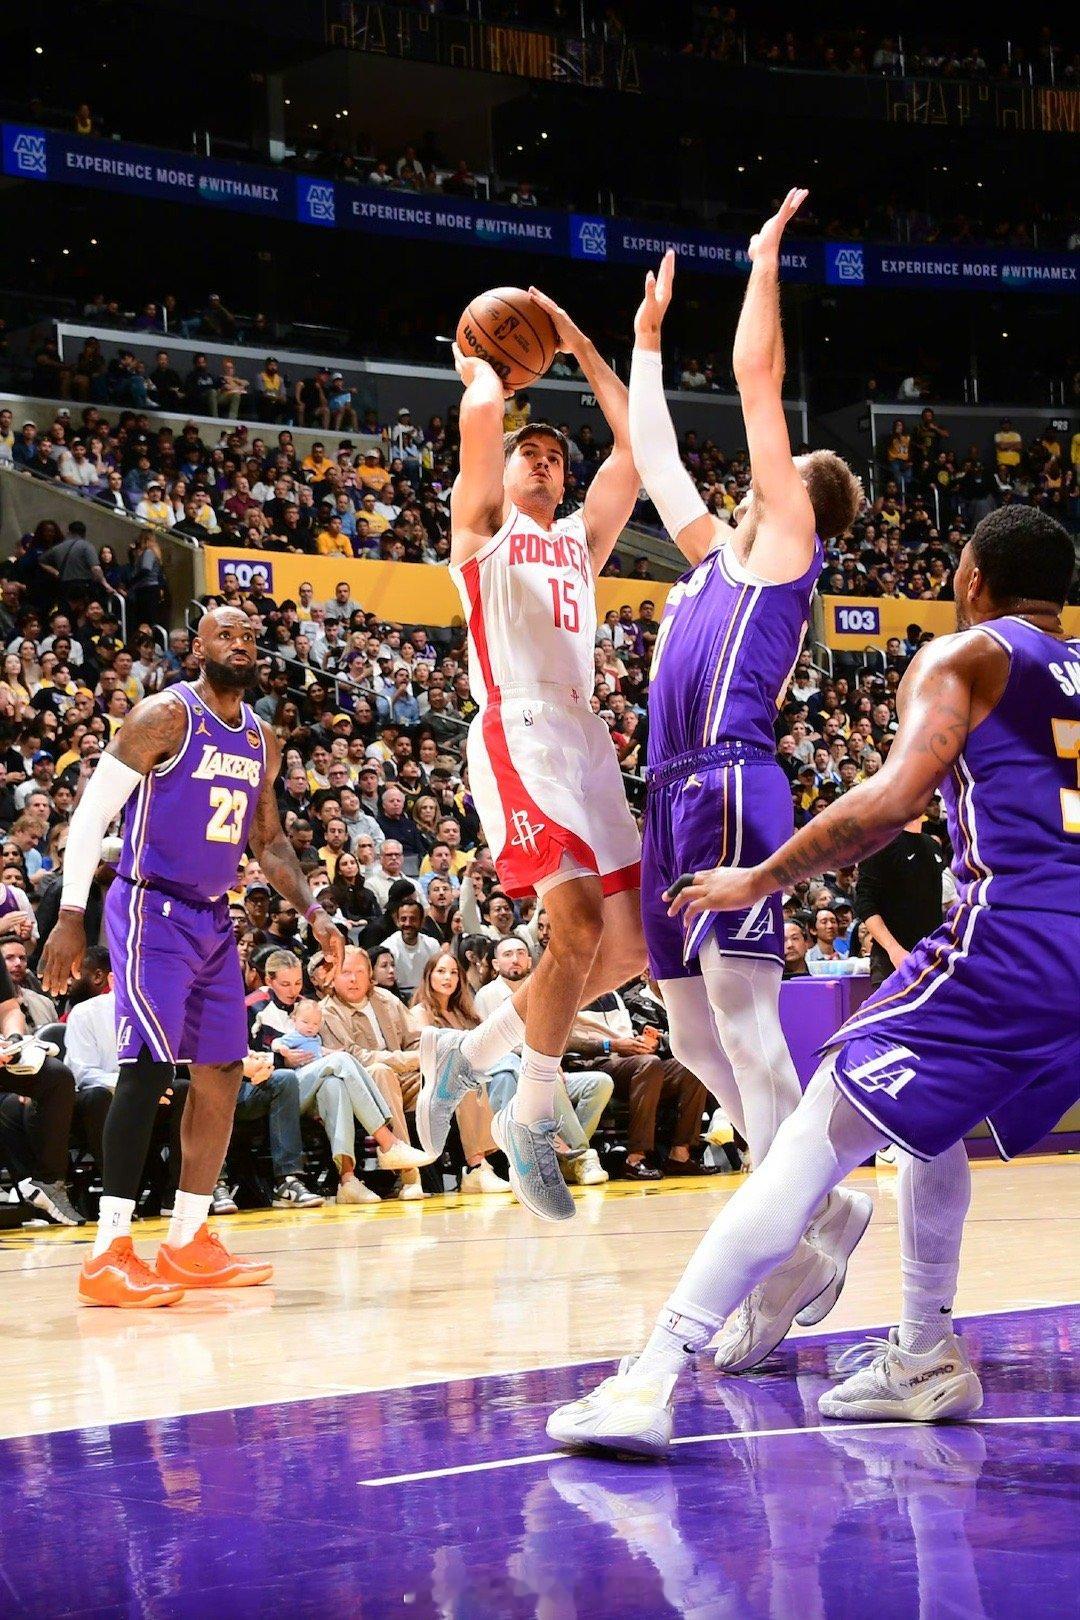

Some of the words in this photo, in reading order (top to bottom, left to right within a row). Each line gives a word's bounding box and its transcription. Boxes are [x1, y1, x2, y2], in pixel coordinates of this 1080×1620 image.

[14, 134, 46, 153] AM
[18, 153, 46, 173] EX
[66, 152, 152, 180] EXPERIENCE
[156, 168, 195, 188] MORE
[199, 175, 279, 201] #WITHAMEX
[307, 185, 335, 204] AM
[311, 202, 335, 220] EX
[352, 201, 432, 225] EXPERIENCE
[435, 212, 472, 230] MORE
[475, 217, 552, 240] #WITHAMEX
[623, 236, 696, 257] EXPERIENCE
[699, 245, 731, 261] MORE
[835, 249, 864, 266] AM
[839, 263, 864, 280] EX
[881, 260, 959, 276] EXPERIENCE
[962, 264, 998, 277] MORE
[1002, 266, 1077, 280] #WITHAMEX
[548, 578, 579, 634] 15
[838, 609, 876, 631] 103
[191, 744, 262, 788] LAKERS
[206, 786, 249, 845] 23
[728, 895, 775, 942] LA
[841, 1044, 920, 1101] LA
